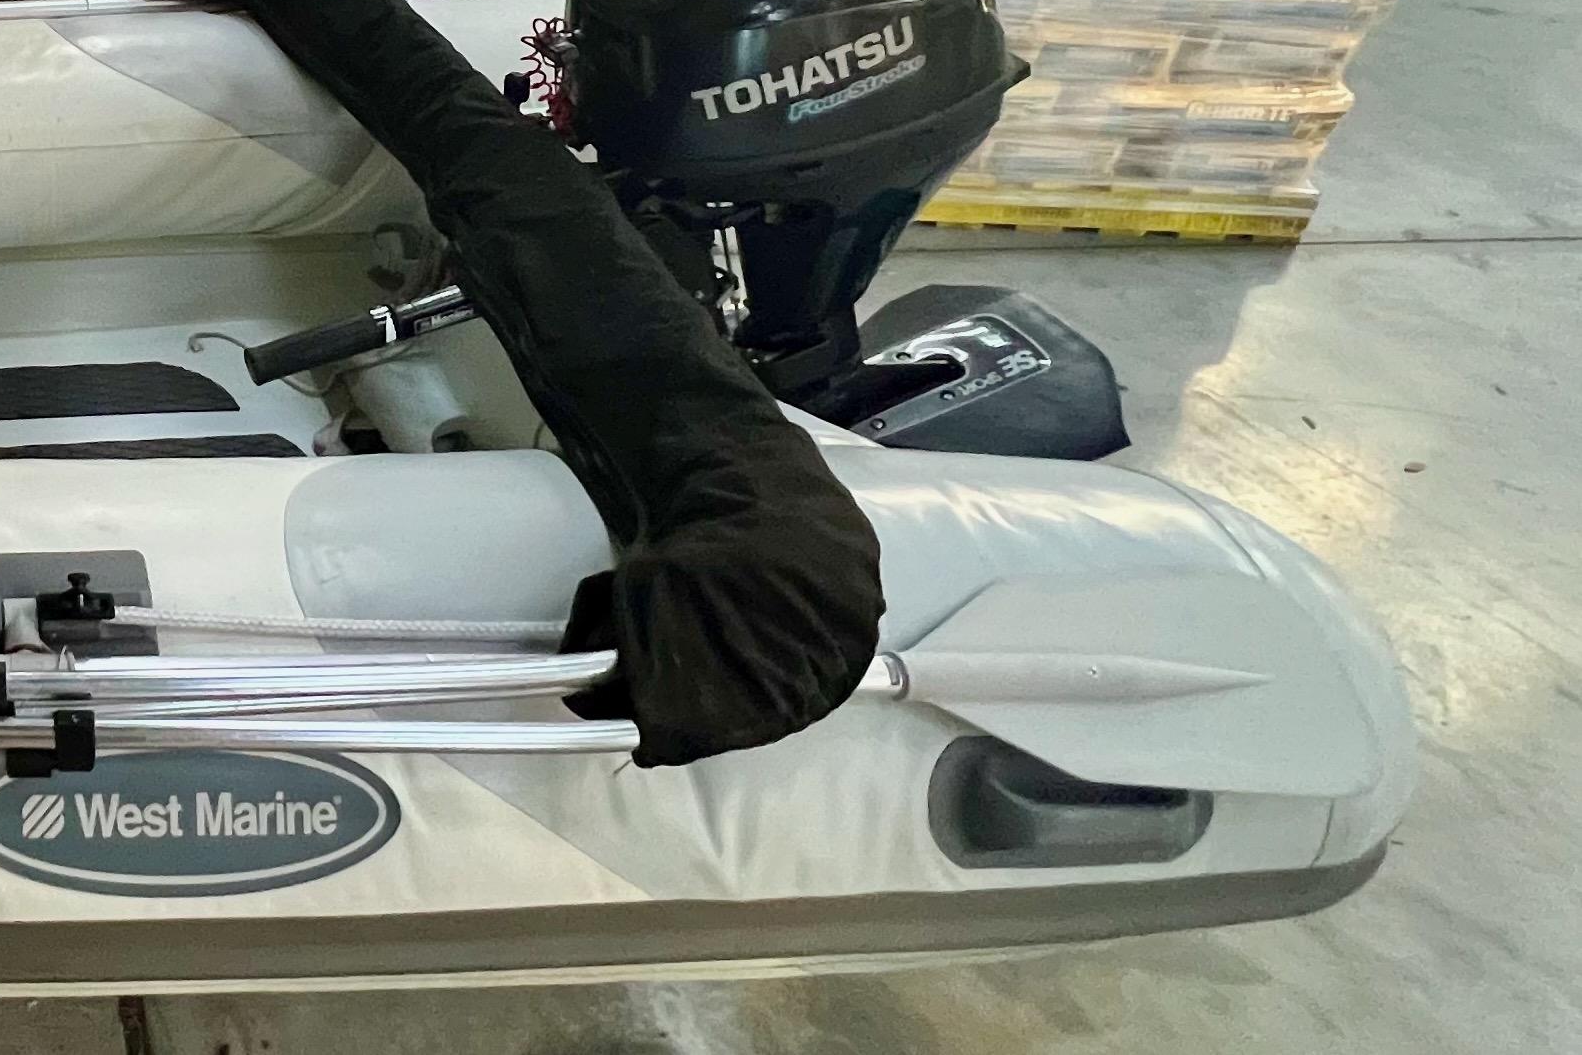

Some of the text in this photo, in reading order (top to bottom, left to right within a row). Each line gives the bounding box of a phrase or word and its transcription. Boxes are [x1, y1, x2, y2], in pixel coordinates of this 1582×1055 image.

[690, 16, 915, 120] TOHATSU
[787, 54, 927, 123] FourStroke
[75, 790, 338, 838] West Marine
